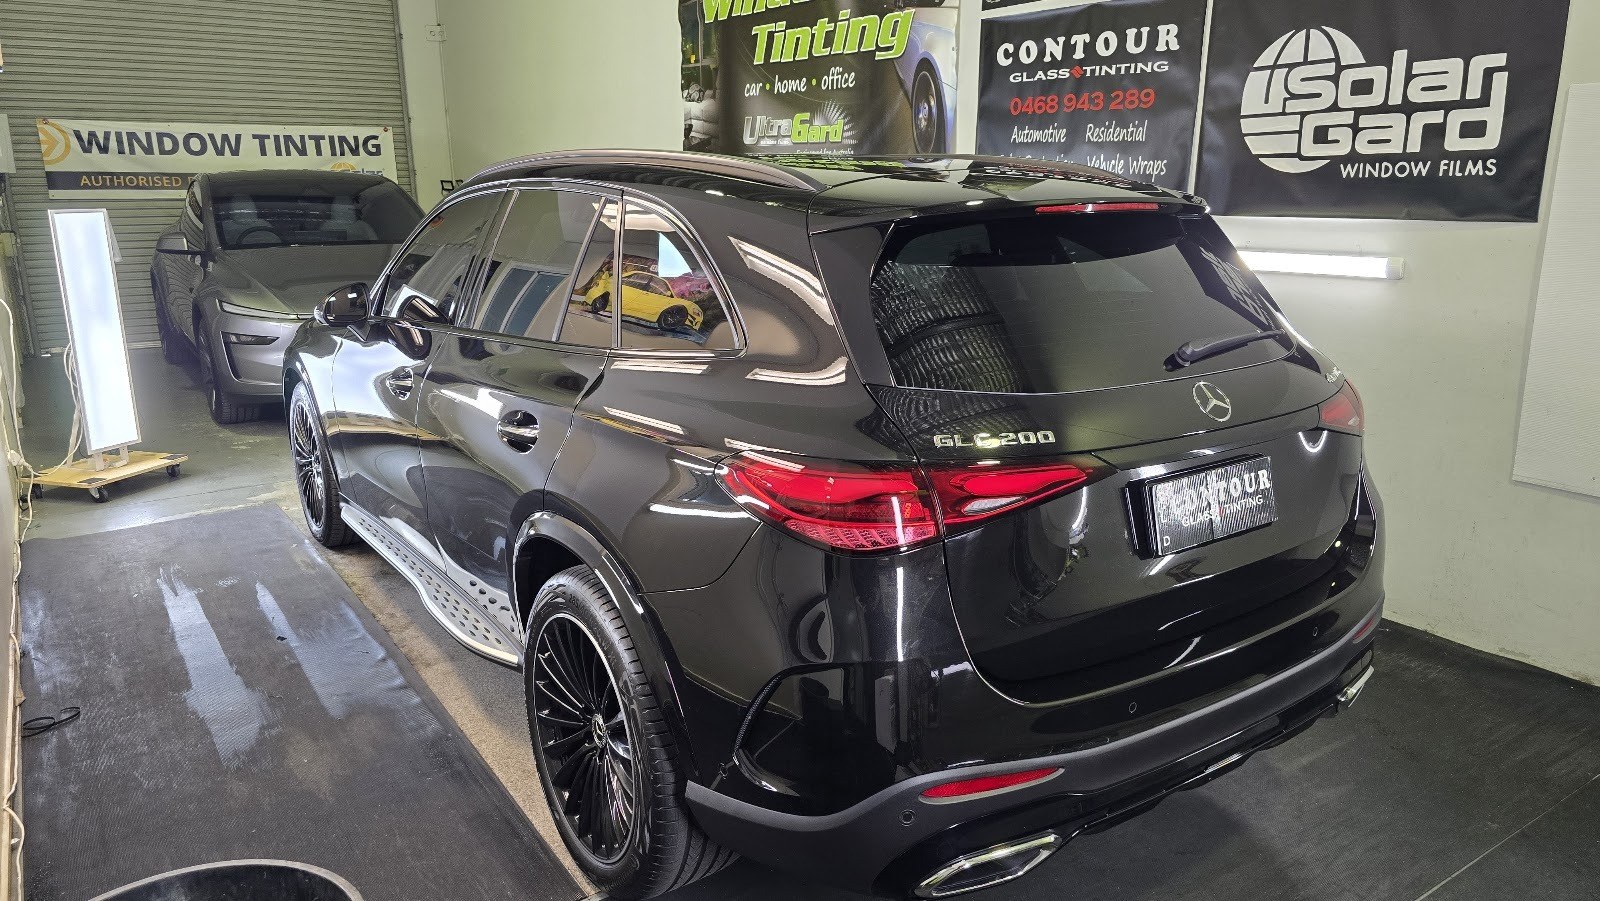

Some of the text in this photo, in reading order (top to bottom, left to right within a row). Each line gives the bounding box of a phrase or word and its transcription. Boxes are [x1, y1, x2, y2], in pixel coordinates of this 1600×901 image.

[752, 9, 915, 66] Tinting
[997, 24, 1180, 67] CONTOUR
[744, 66, 856, 97] car home office
[1009, 61, 1169, 83] GLASS TINTING
[1285, 50, 1508, 113] Solar
[1009, 88, 1156, 116] 0468 943 289
[1301, 71, 1509, 157] Gard
[743, 112, 845, 145] UltraGard
[1010, 120, 1148, 144] Automotive Residential
[73, 129, 382, 157] WINDOW TINTING
[80, 175, 182, 187] AUTHORISED
[1129, 155, 1168, 182] Wraps
[1340, 158, 1497, 179] WINDOW FILMS
[999, 430, 1056, 445] 200
[1223, 495, 1264, 514] TINTING
